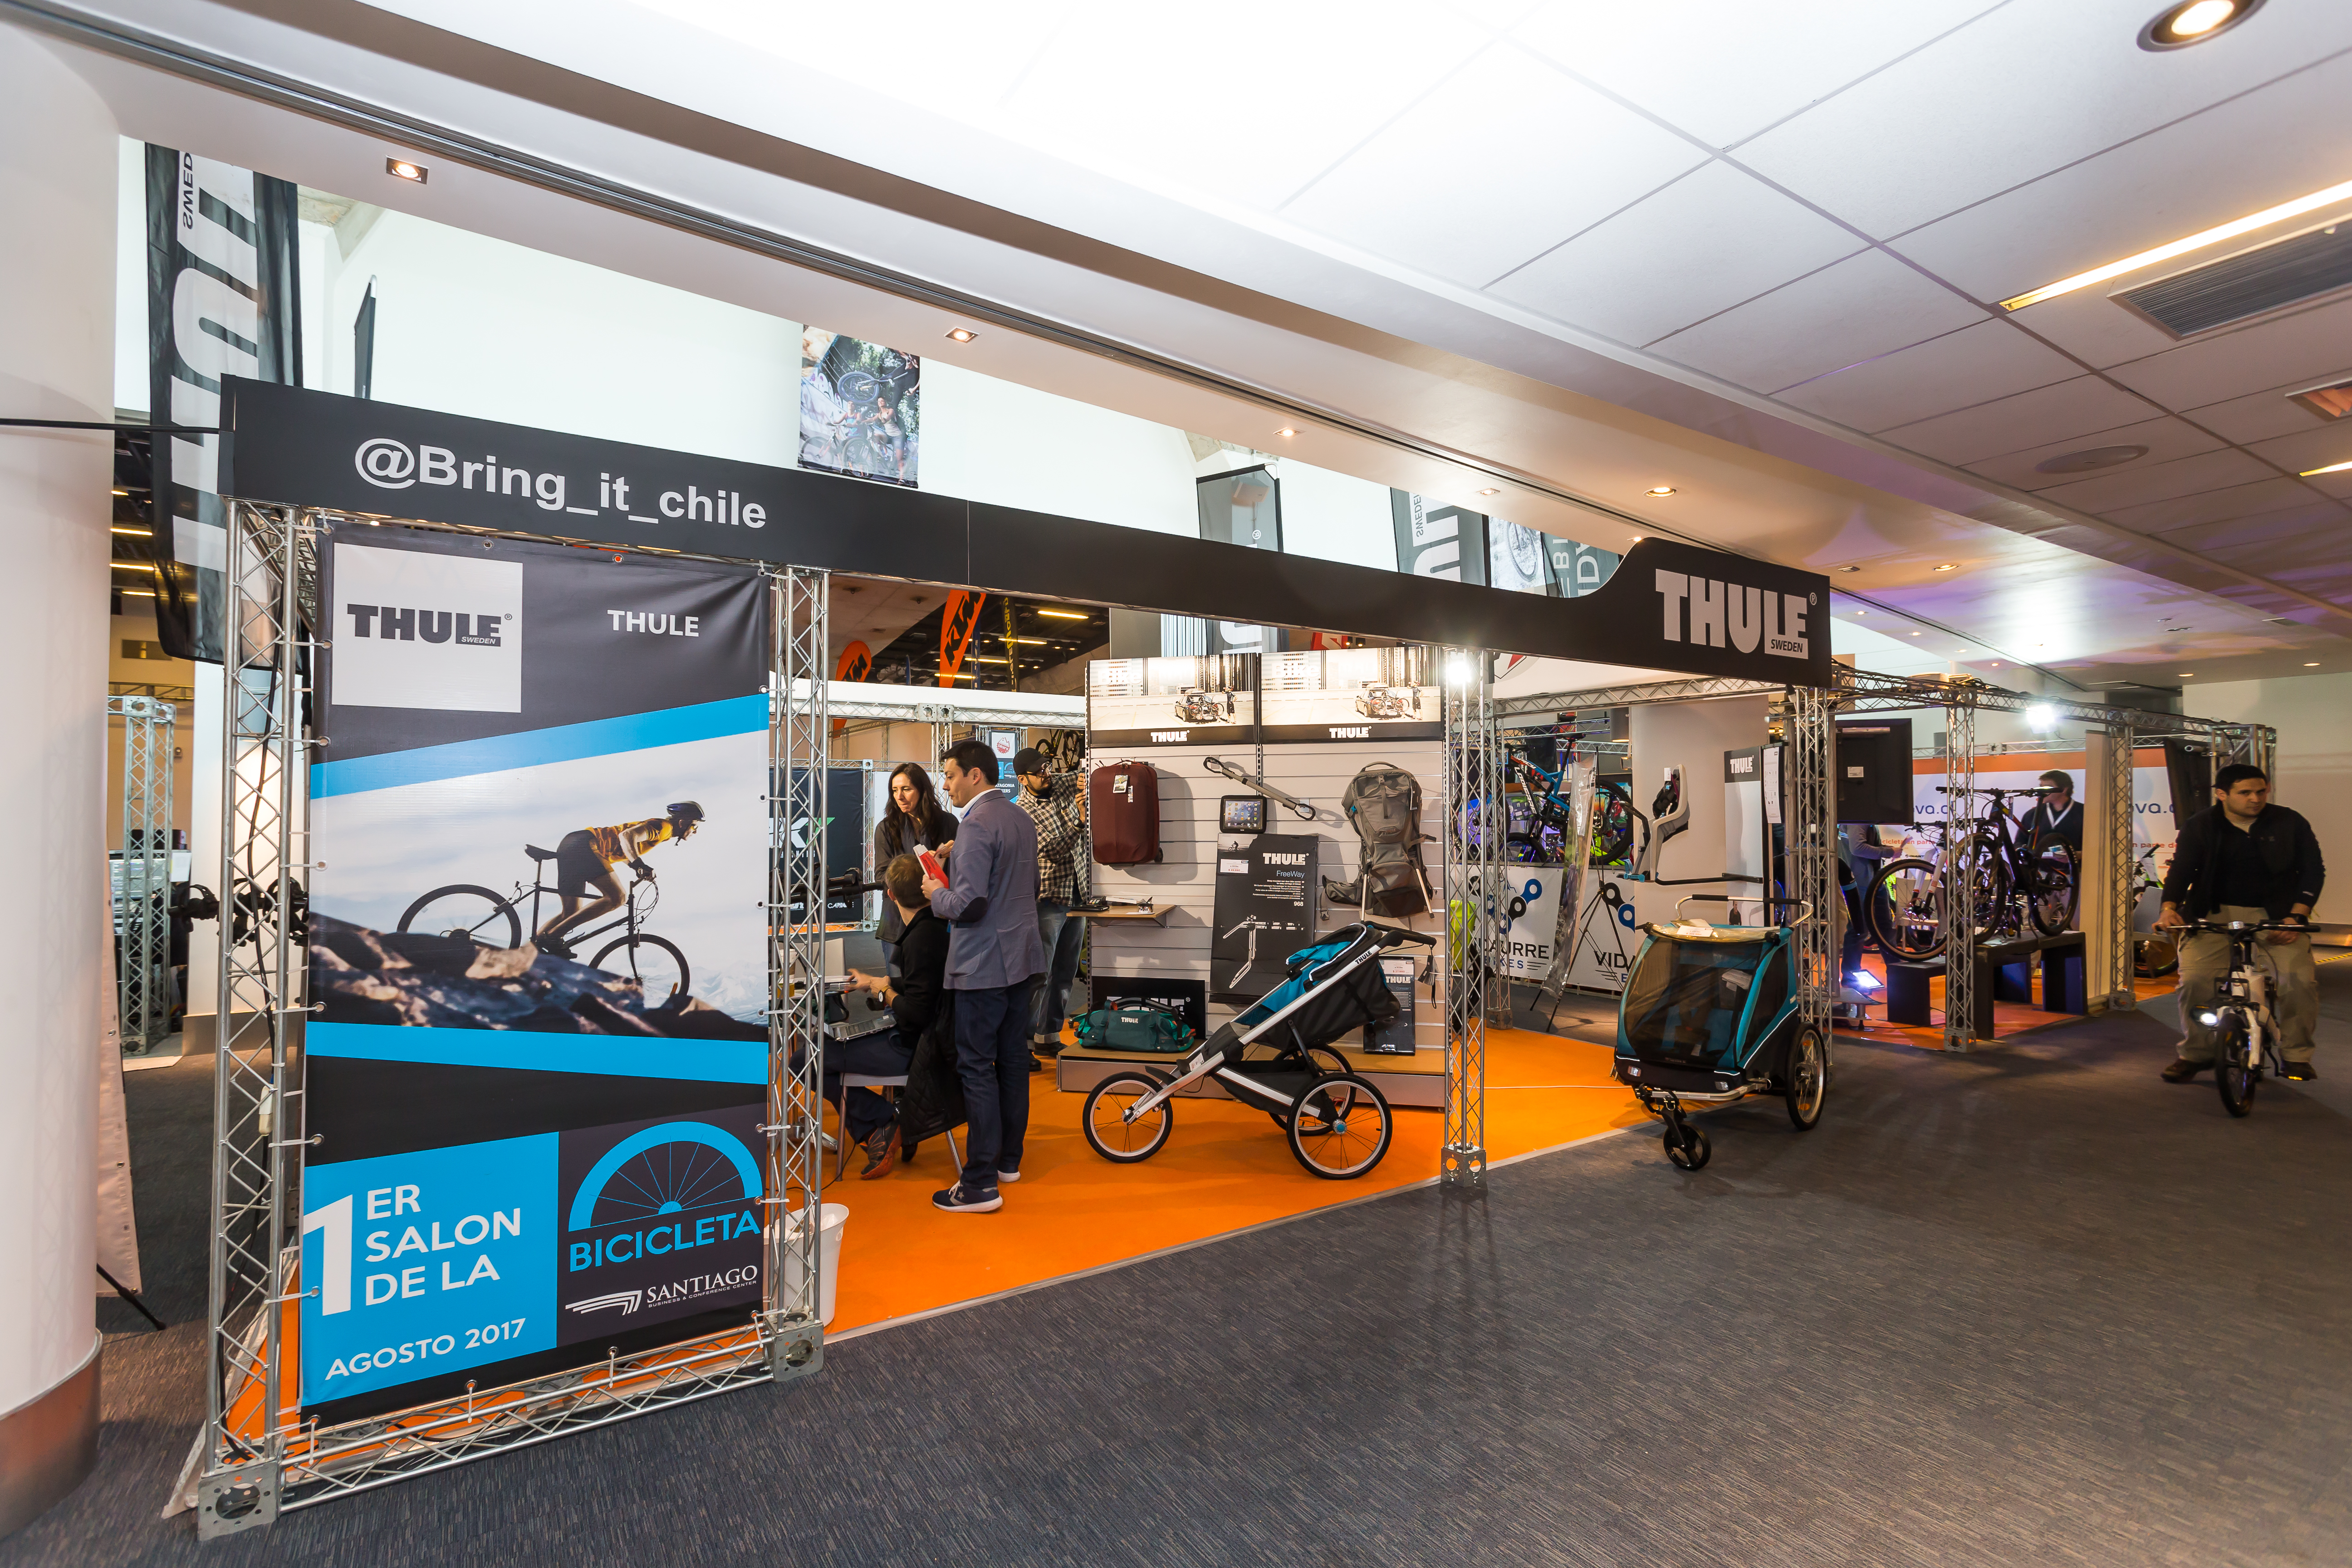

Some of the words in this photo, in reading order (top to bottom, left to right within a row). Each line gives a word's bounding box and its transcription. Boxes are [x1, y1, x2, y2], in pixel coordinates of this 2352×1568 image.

[355, 438, 767, 529] @Bring_it_chile
[347, 604, 501, 647] THULE
[607, 609, 699, 637] THULE
[1656, 569, 1808, 659] THULE
[461, 635, 496, 645] SWEDEN
[1770, 639, 1803, 653] SWEDEN
[1150, 730, 1188, 743] THULE
[1329, 726, 1369, 739] THULE
[1730, 756, 1753, 774] THULE
[1263, 853, 1306, 865] THULE
[1276, 870, 1305, 879] FreeWay
[1355, 950, 1372, 965] THULE
[365, 1207, 521, 1263] SALON
[569, 1209, 761, 1272] BICICLETA
[304, 1194, 353, 1316] 1
[367, 1184, 421, 1220] ER
[365, 1265, 426, 1306] DE
[441, 1254, 501, 1291] LA
[647, 1265, 758, 1303] SANTIAGO
[648, 1298, 681, 1308] BUSINESS
[688, 1286, 730, 1299] CONFERENCE
[732, 1280, 757, 1289] CENTER
[324, 1334, 456, 1381] AGOSTO
[464, 1318, 526, 1349] 2017
